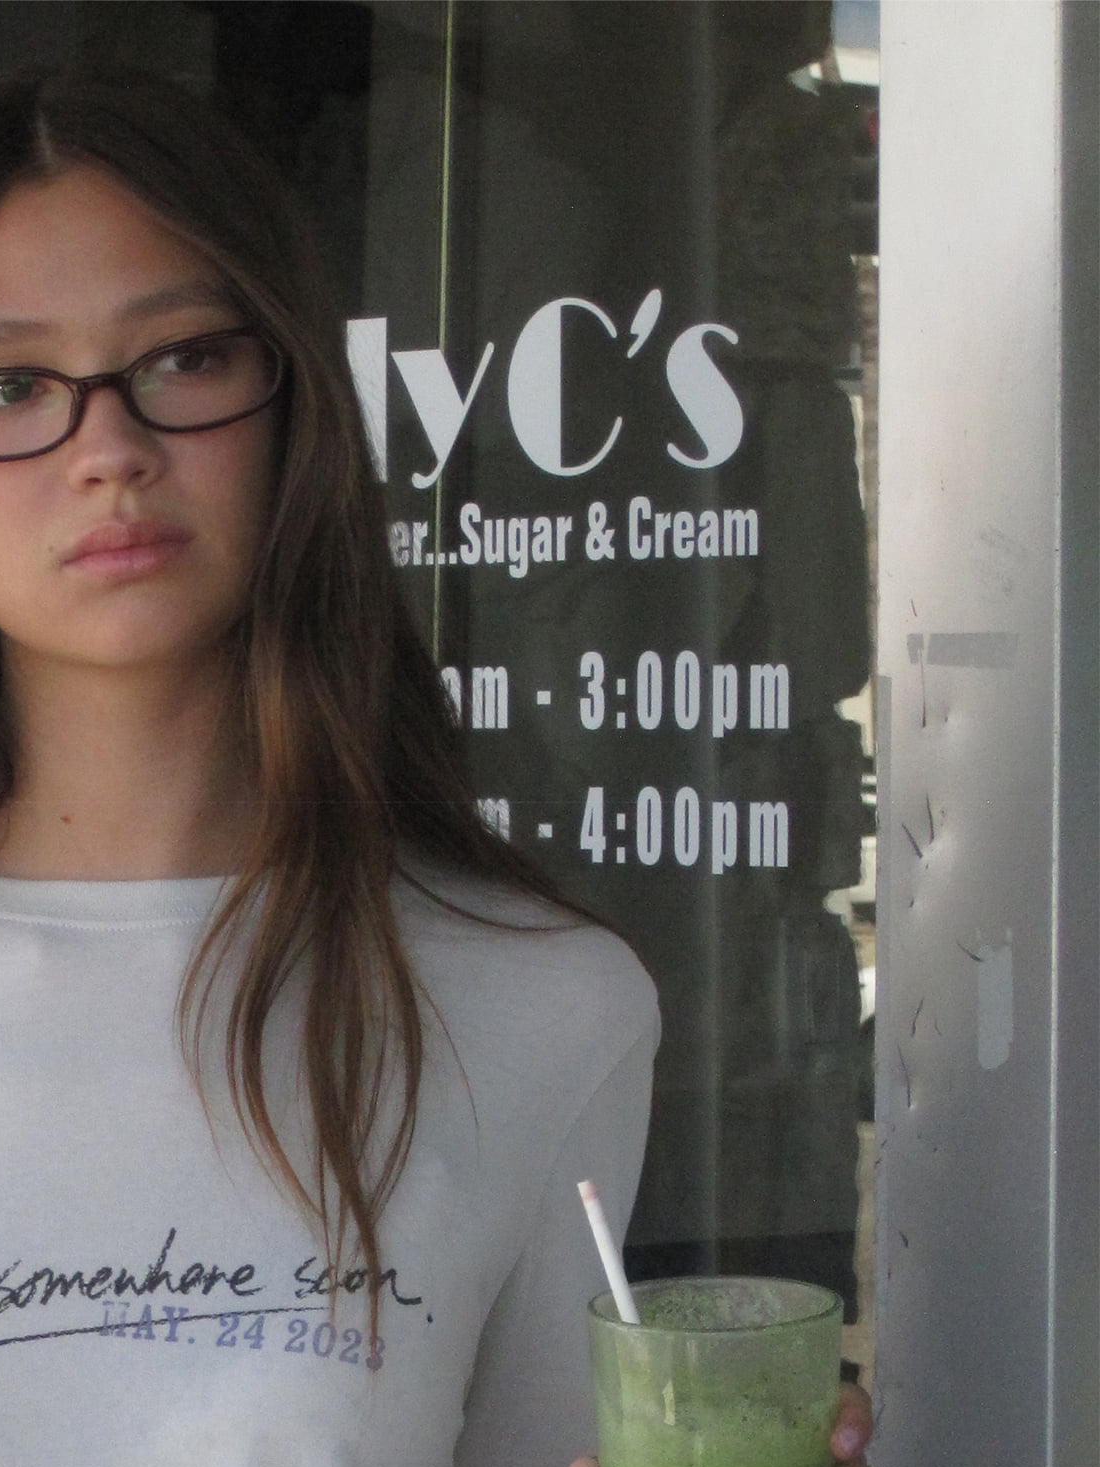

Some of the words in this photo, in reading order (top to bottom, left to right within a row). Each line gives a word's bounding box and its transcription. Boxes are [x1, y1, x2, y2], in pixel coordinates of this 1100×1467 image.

[585, 502, 615, 561] &
[629, 496, 758, 560] Cream
[580, 650, 789, 738] 3:00pm
[580, 786, 789, 875] 4:00pm
[216, 1312, 265, 1349] 24
